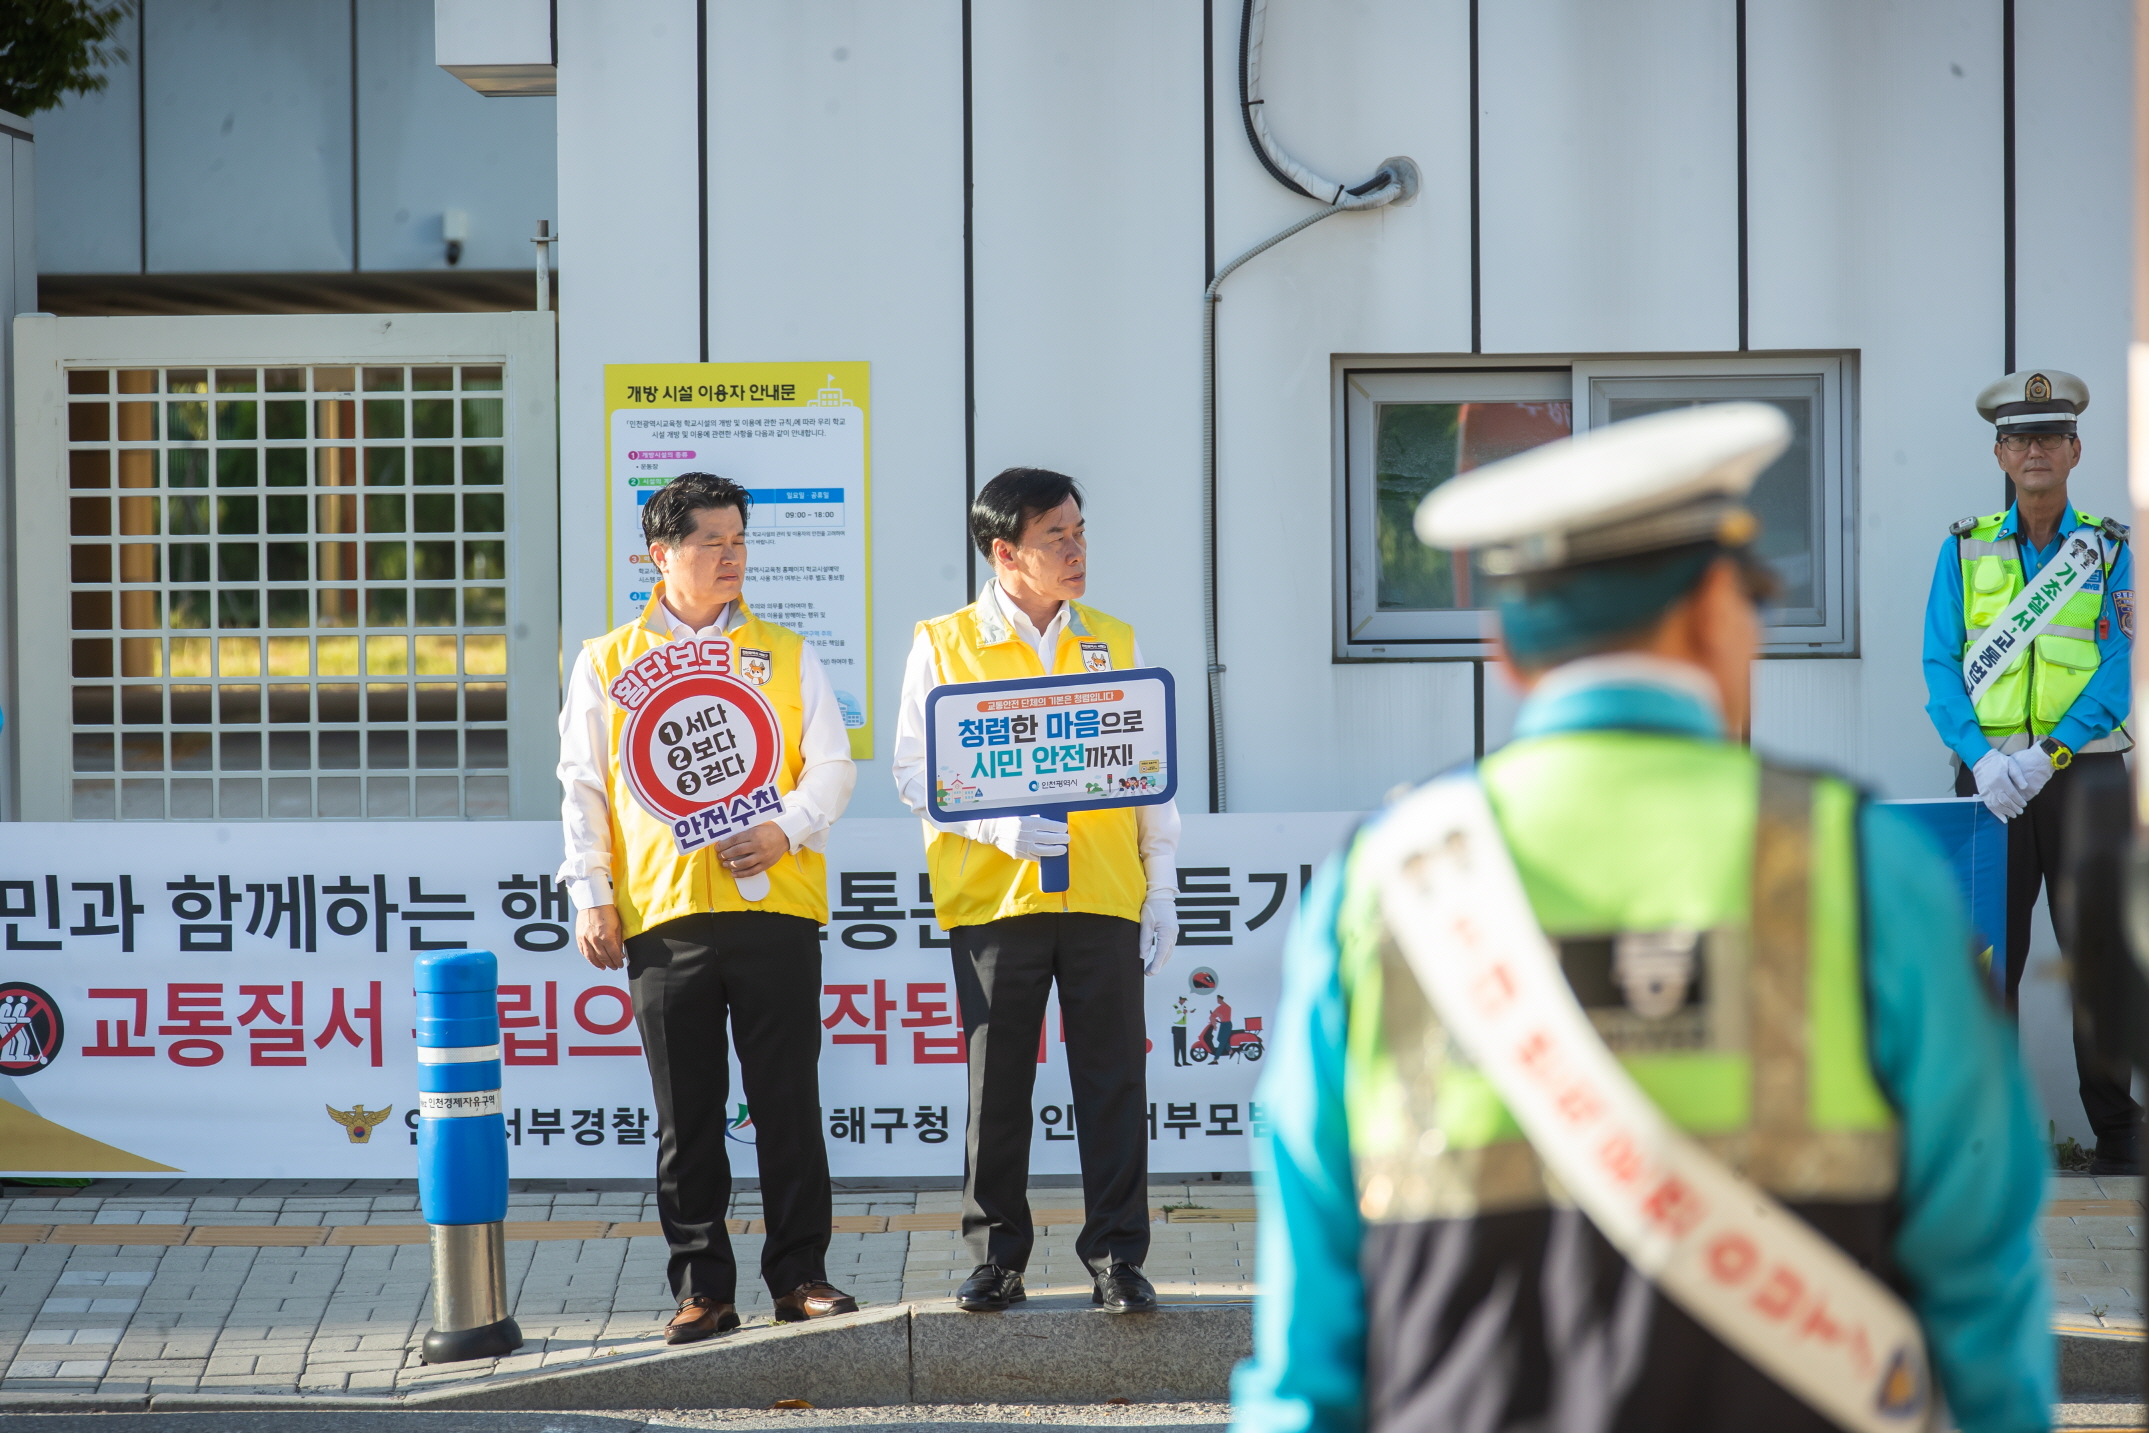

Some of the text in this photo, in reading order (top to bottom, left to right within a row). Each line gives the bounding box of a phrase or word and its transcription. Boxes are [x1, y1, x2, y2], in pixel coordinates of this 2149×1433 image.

[627, 384, 796, 403] 개방 시설 이용자 안내문
[652, 431, 665, 439] 시설
[667, 431, 680, 439] 개방
[711, 430, 732, 438] 관련한
[733, 430, 753, 438] 사항을
[776, 429, 790, 437] 같이
[791, 429, 827, 437] 안내합니다.
[684, 419, 717, 427] 학교시설의
[719, 419, 732, 427] 개방
[734, 419, 740, 427] 및
[742, 419, 762, 427] 이용에
[763, 419, 777, 427] 관한
[802, 418, 816, 426] 따라
[811, 491, 829, 499] 공휴일
[611, 641, 730, 710] 횡단보도
[987, 691, 1115, 711] 교통안전 단체의 기본은 청렴입니다
[686, 703, 728, 736] 서다
[958, 709, 1144, 748] 청렴한 마음으로
[692, 728, 736, 762] 보다
[970, 743, 1133, 779] 시민 안전까지!
[701, 753, 746, 786] 걷다
[1041, 778, 1078, 790] 인천광역시
[674, 785, 783, 850] 안전수칙
[166, 874, 476, 953] 함께하는
[82, 981, 384, 1069] 교통질서
[428, 1094, 495, 1109] 인천경제자유구역
